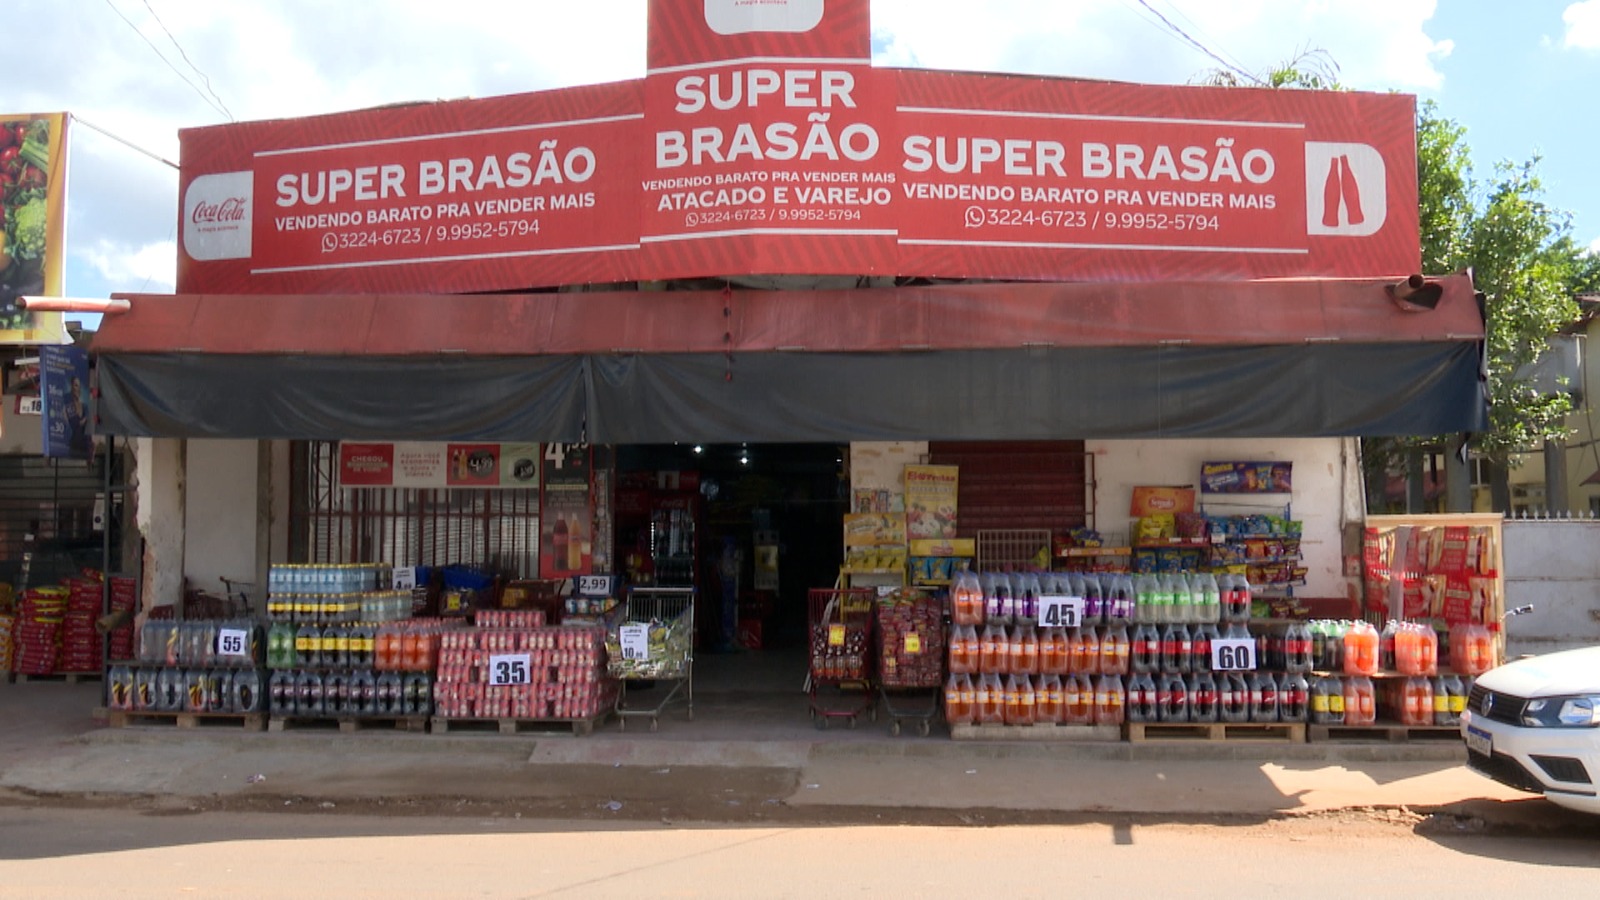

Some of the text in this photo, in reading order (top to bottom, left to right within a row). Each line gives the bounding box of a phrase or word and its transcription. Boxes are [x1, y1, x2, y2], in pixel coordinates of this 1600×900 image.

[674, 69, 857, 114] SUPER
[655, 111, 880, 169] BRASÃO
[902, 133, 1276, 185] SUPER BRASÃO
[276, 140, 596, 207] SUPER BRASÃO
[641, 170, 896, 191] VENDENDO BARATO PRA VENDER MAIS
[657, 186, 892, 212] ATACADO E VAREJO
[902, 182, 1276, 211] VENDENDO BARATO PRA VENDER MAIS
[275, 192, 596, 231] VENDENDO BARATO PRA VENDER MAIS
[699, 208, 861, 225] 3224-6723 / 9.9952-5794
[987, 208, 1220, 231] 3224-6723 / 9.9952-5794
[340, 219, 541, 249] 3224-6723 / 9.9952-5794
[580, 579, 606, 591] 2,99
[1045, 604, 1075, 626] 45
[223, 636, 241, 652] 55
[1219, 646, 1250, 669] 60
[496, 661, 525, 684] 35
